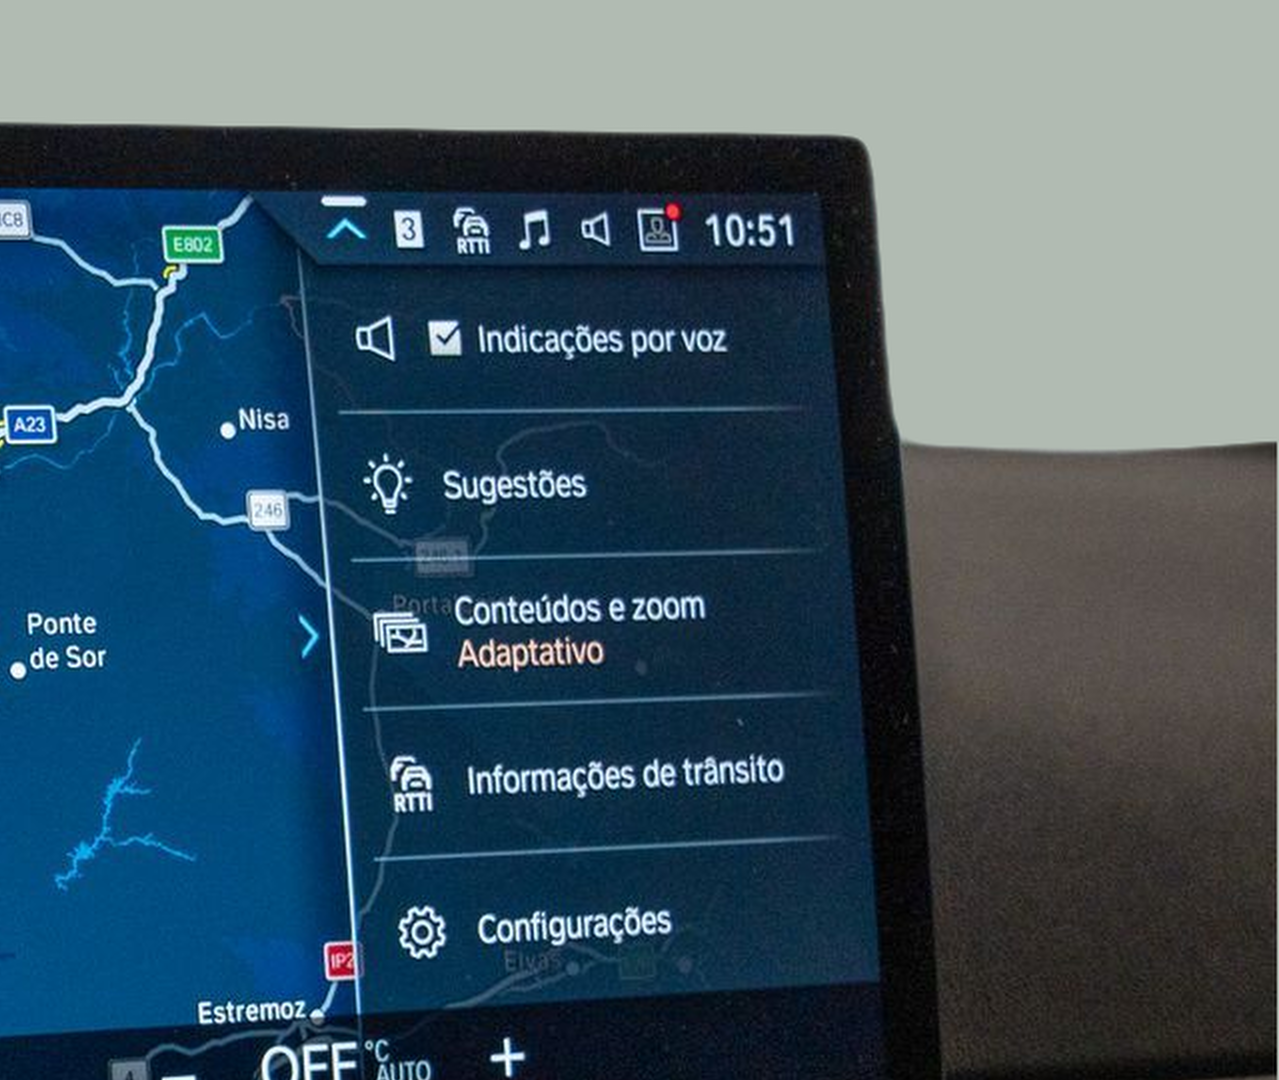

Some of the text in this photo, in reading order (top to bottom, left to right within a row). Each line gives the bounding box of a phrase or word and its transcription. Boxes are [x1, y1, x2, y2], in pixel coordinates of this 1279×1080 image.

[401, 217, 417, 242] 3
[704, 213, 796, 249] 10:51
[172, 236, 213, 254] E802
[456, 236, 491, 255] RTTI
[477, 324, 728, 360] Indicações por voz
[13, 415, 46, 434] A23
[238, 408, 290, 432] Nisa
[442, 469, 587, 505] Sugestões
[454, 593, 706, 627] Conteúdos e zoom
[26, 612, 98, 636] Ponte
[29, 644, 107, 670] de Sor
[458, 636, 605, 673] Adaptativo
[467, 753, 785, 798] Informações de trânsito
[394, 793, 433, 812] RTTI
[478, 907, 672, 946] Configurações
[197, 999, 308, 1026] Estremoz
